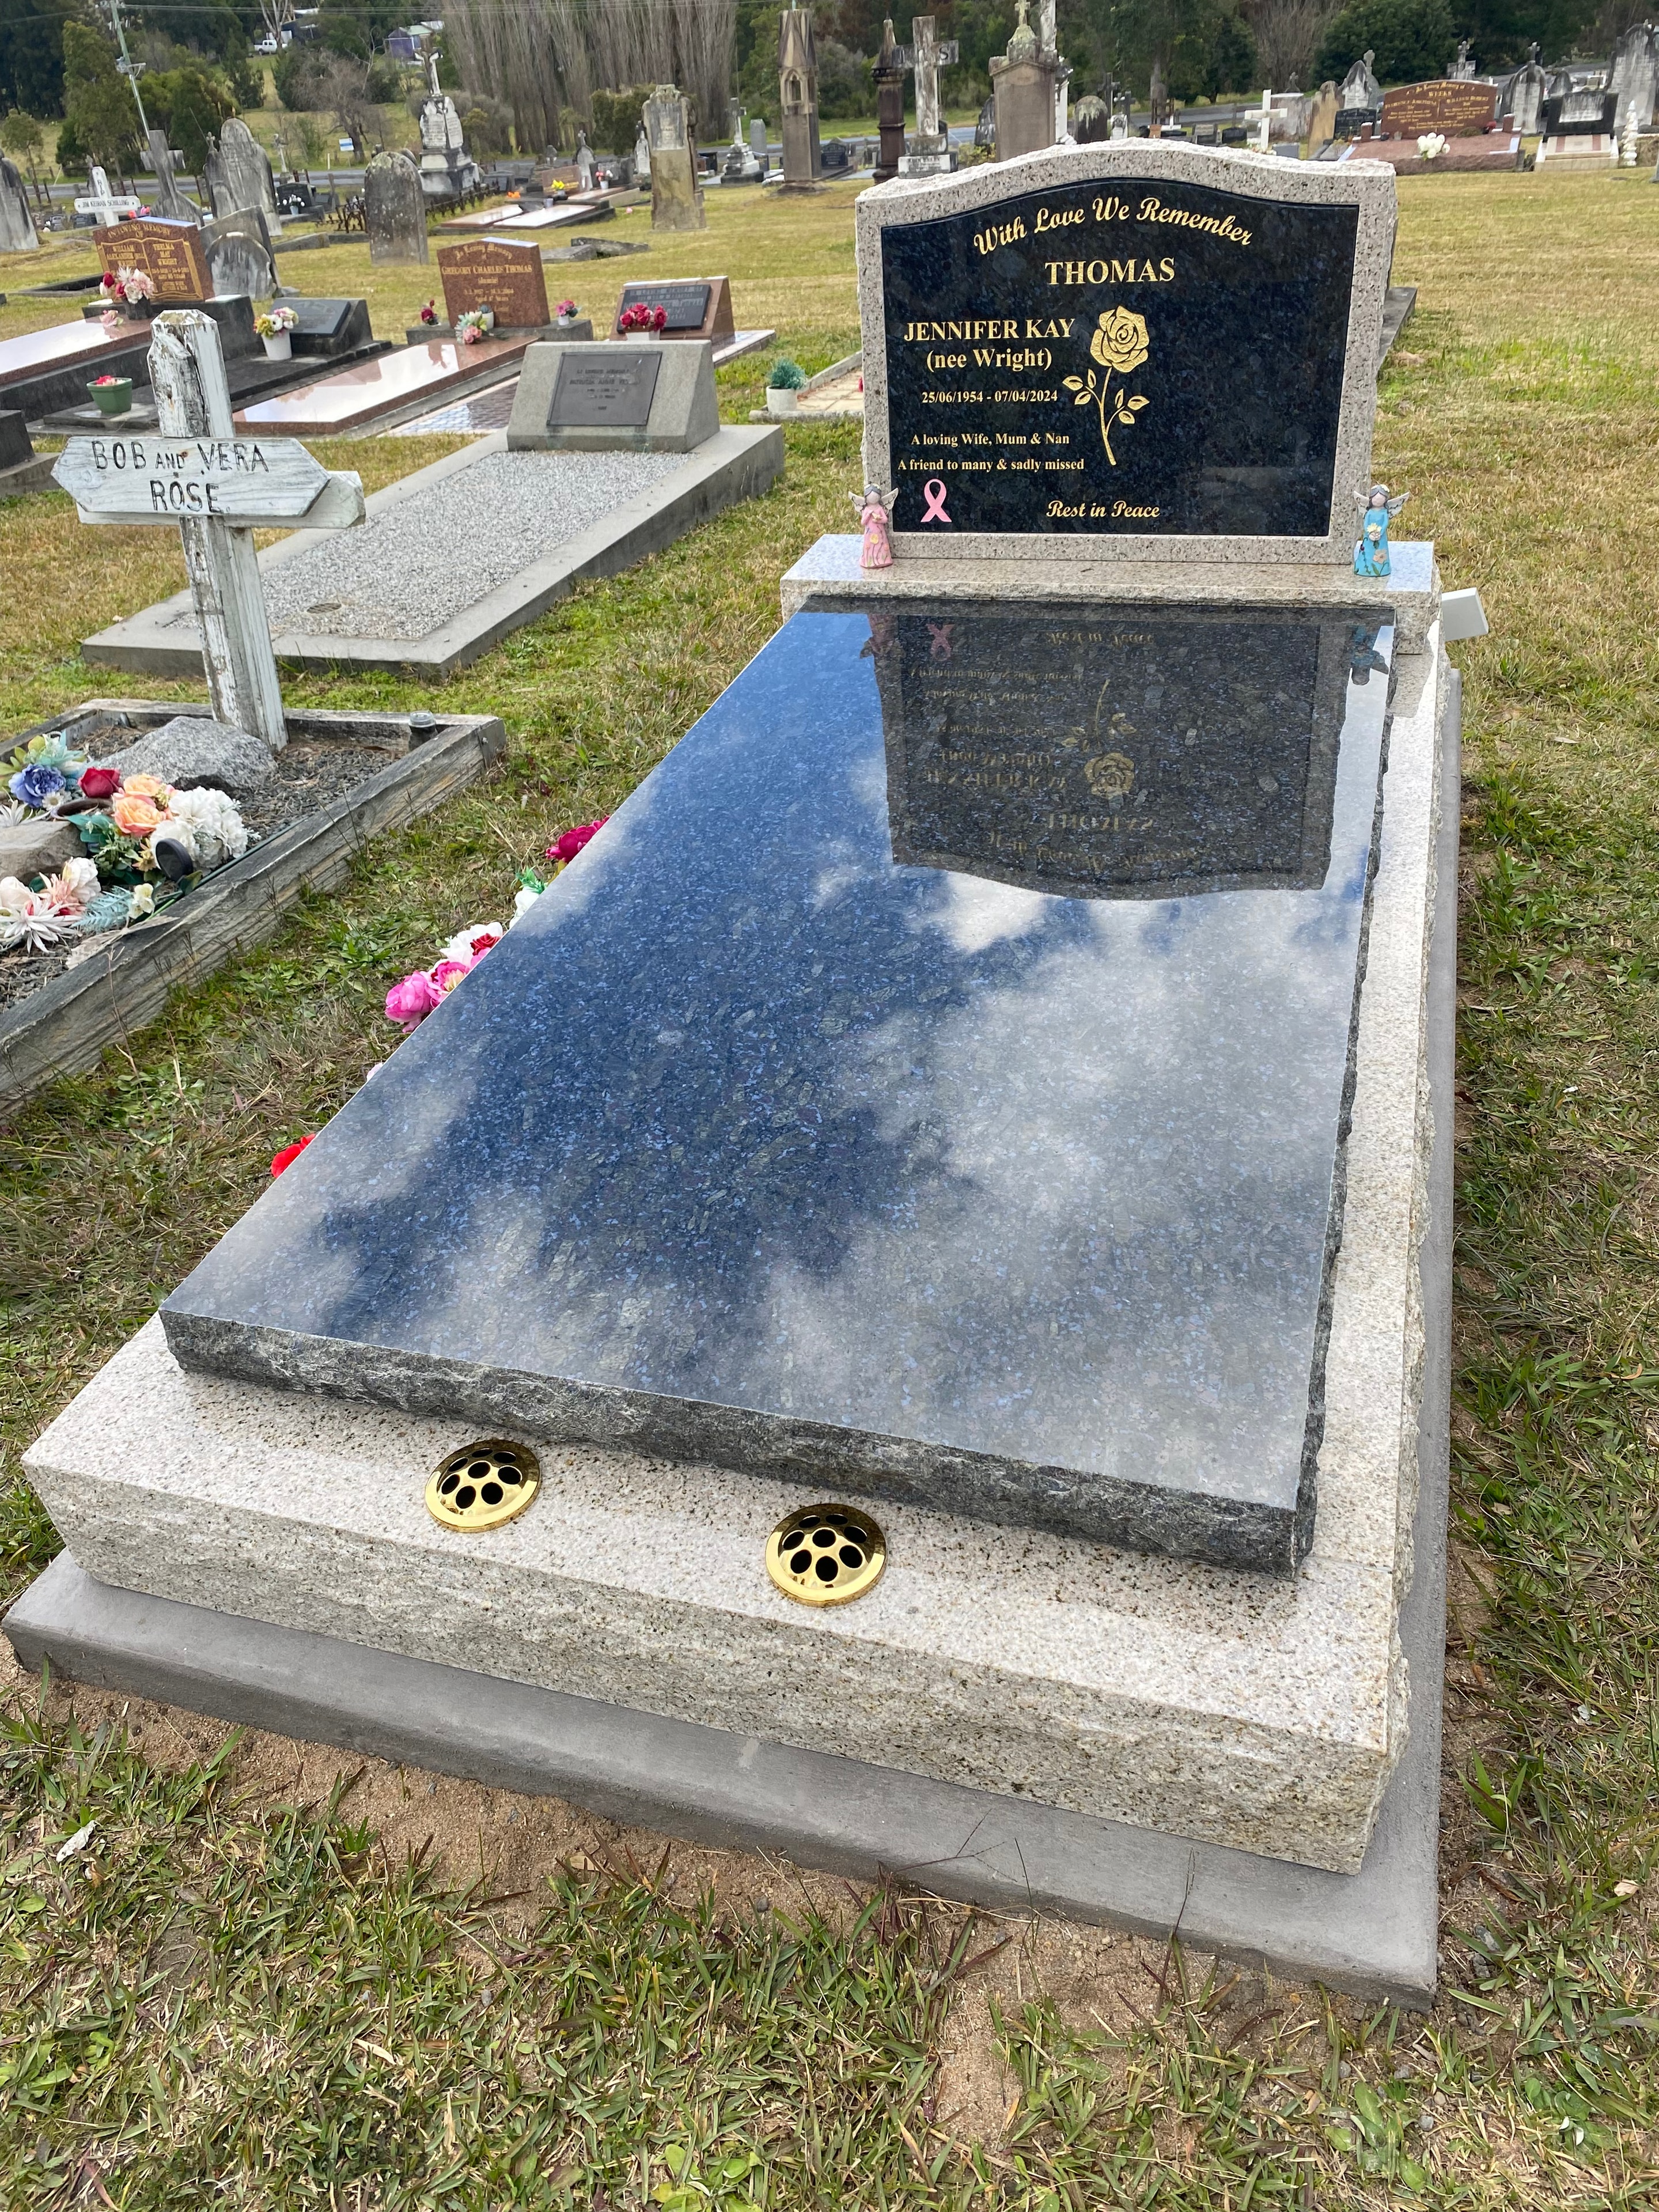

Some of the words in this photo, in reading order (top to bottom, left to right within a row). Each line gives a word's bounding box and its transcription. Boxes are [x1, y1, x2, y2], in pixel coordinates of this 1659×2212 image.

[117, 223, 141, 234] LOVING
[142, 223, 171, 236] MEMORY
[974, 216, 1027, 255] With
[1034, 207, 1085, 234] Love
[1092, 196, 1130, 221] We
[1136, 197, 1252, 246] Remember
[472, 264, 503, 274] CHARLES
[505, 264, 533, 273] THOMAS
[1044, 257, 1176, 286] THOMAS
[903, 320, 1019, 342] JENNIFER
[1025, 318, 1075, 339] KAY
[926, 351, 967, 372] (nee
[972, 348, 1052, 372] Wright)
[922, 391, 983, 403] 25/06/1954
[994, 389, 1058, 402] 07/04/2024
[911, 434, 921, 445] A
[923, 434, 958, 448] loving
[961, 433, 992, 446] Wife,
[995, 433, 1027, 445] Mum
[1030, 433, 1041, 445] &
[1045, 433, 1070, 445] Nan
[91, 440, 147, 470] BOB
[196, 442, 270, 472] VERA
[897, 460, 907, 471] A
[910, 459, 944, 471] friend
[946, 460, 959, 471] to
[961, 461, 993, 472] many
[996, 458, 1008, 471] &
[1011, 459, 1041, 472] sadly
[1044, 459, 1085, 470] missed
[1046, 500, 1086, 518] Rest
[1090, 503, 1107, 518] in
[1111, 499, 1160, 518] Peace
